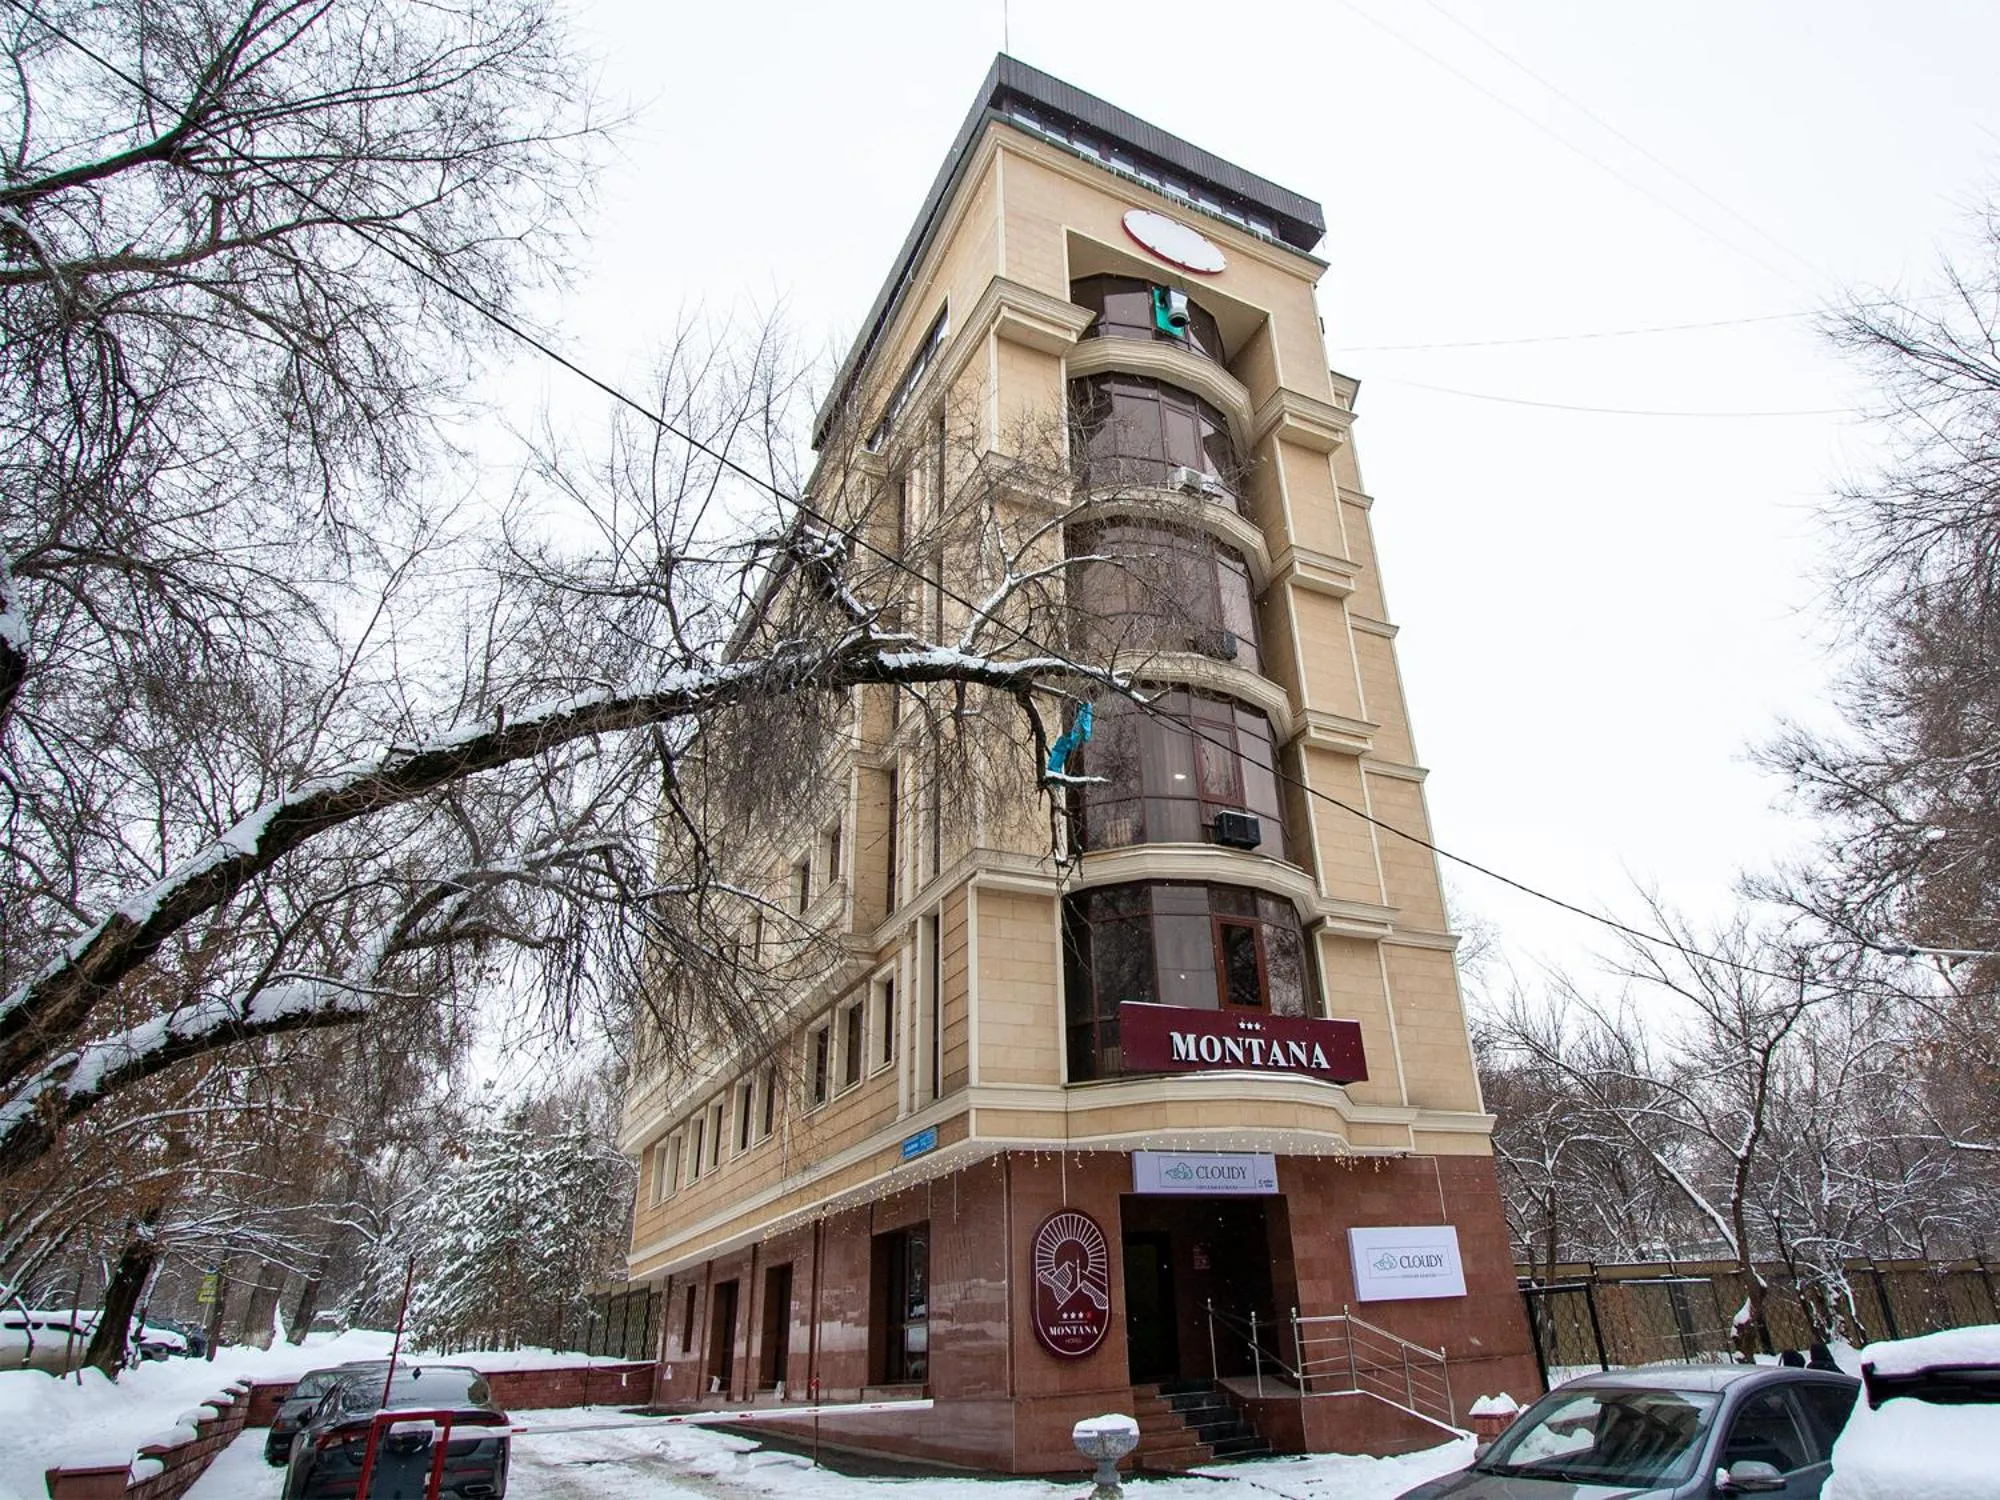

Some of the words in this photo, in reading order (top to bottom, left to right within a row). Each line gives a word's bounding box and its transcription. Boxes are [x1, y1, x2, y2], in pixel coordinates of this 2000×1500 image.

[1169, 1031, 1331, 1069] MONTANA
[1196, 1165, 1248, 1180] CLOUDY
[1400, 1254, 1444, 1269] CLOUDY
[1049, 1325, 1098, 1336] MONTANA
